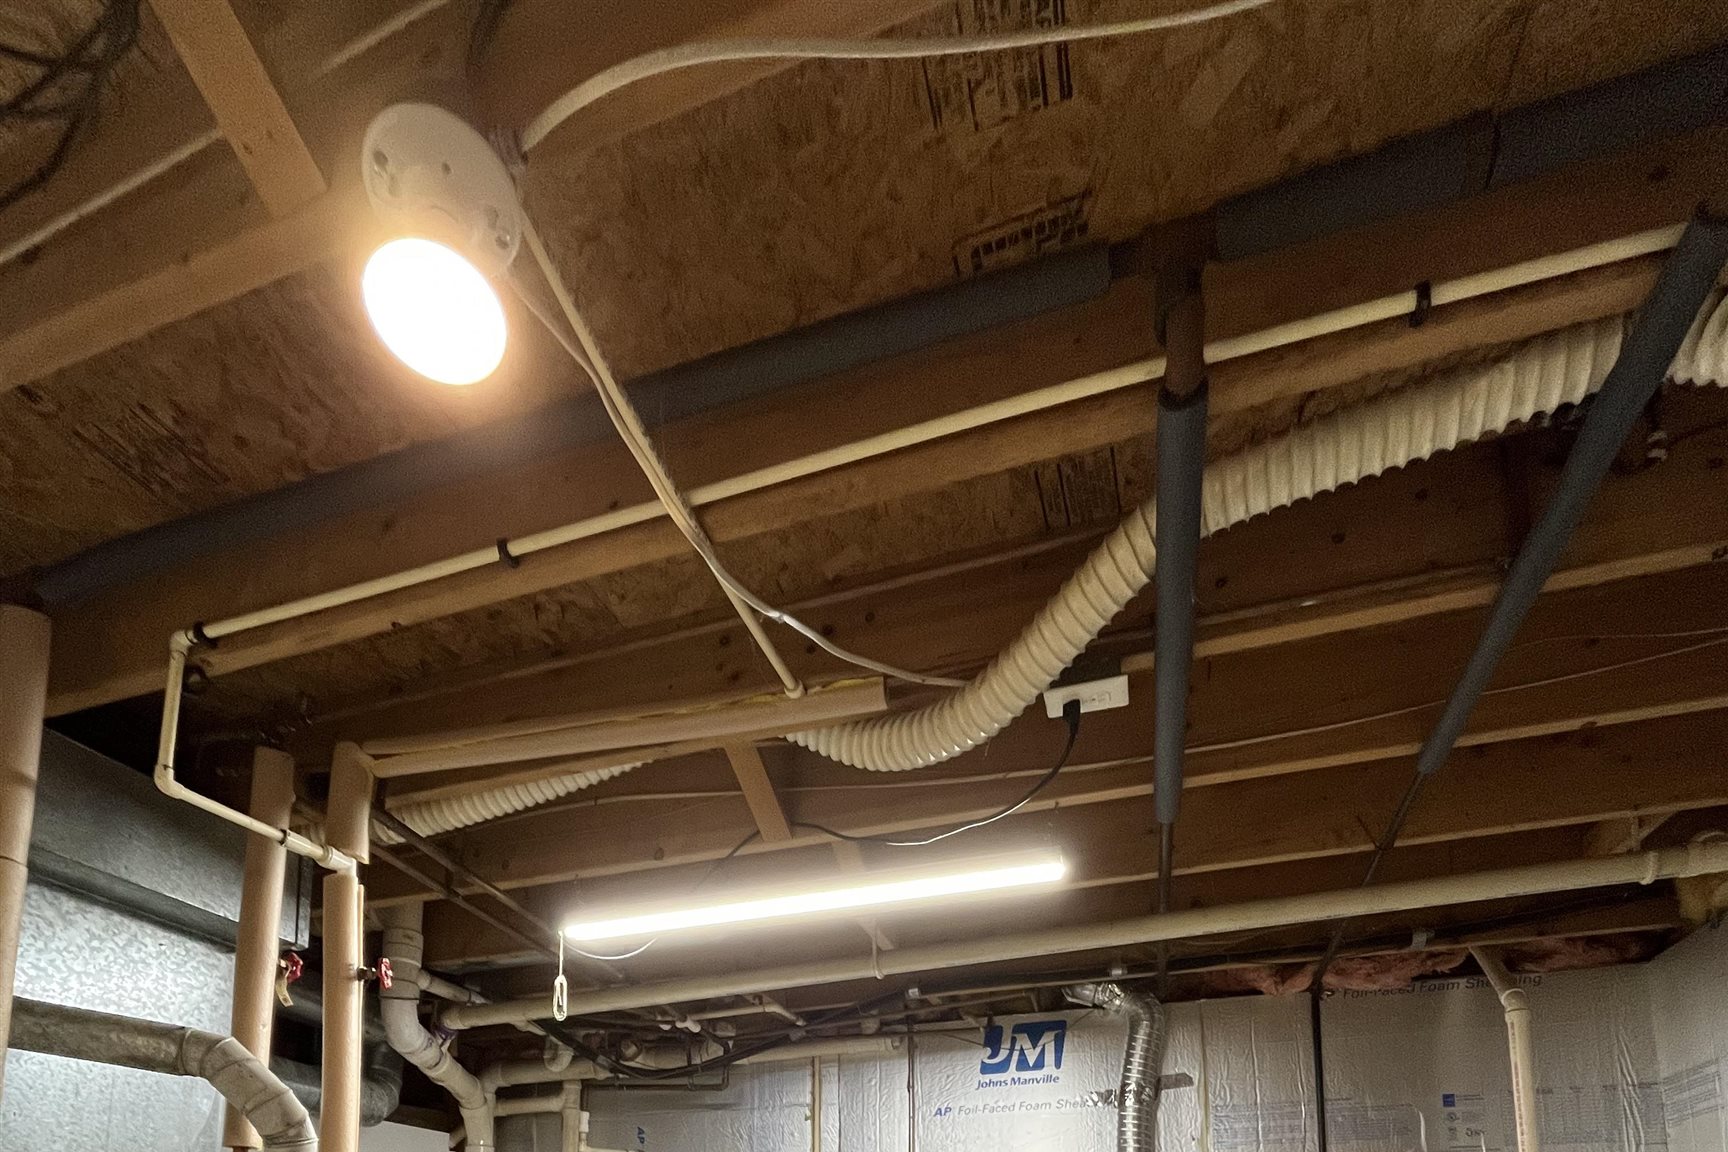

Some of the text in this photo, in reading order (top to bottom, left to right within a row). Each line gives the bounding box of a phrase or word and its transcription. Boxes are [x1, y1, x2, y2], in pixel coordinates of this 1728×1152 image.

[1420, 980, 1459, 993] Foam
[980, 1020, 1067, 1075] JM
[976, 1074, 1060, 1090] Johns Manville
[934, 1107, 953, 1117] AP
[957, 1102, 1016, 1116] Foil-Faced
[1019, 1100, 1052, 1111] Foam
[637, 1126, 645, 1144] AP
